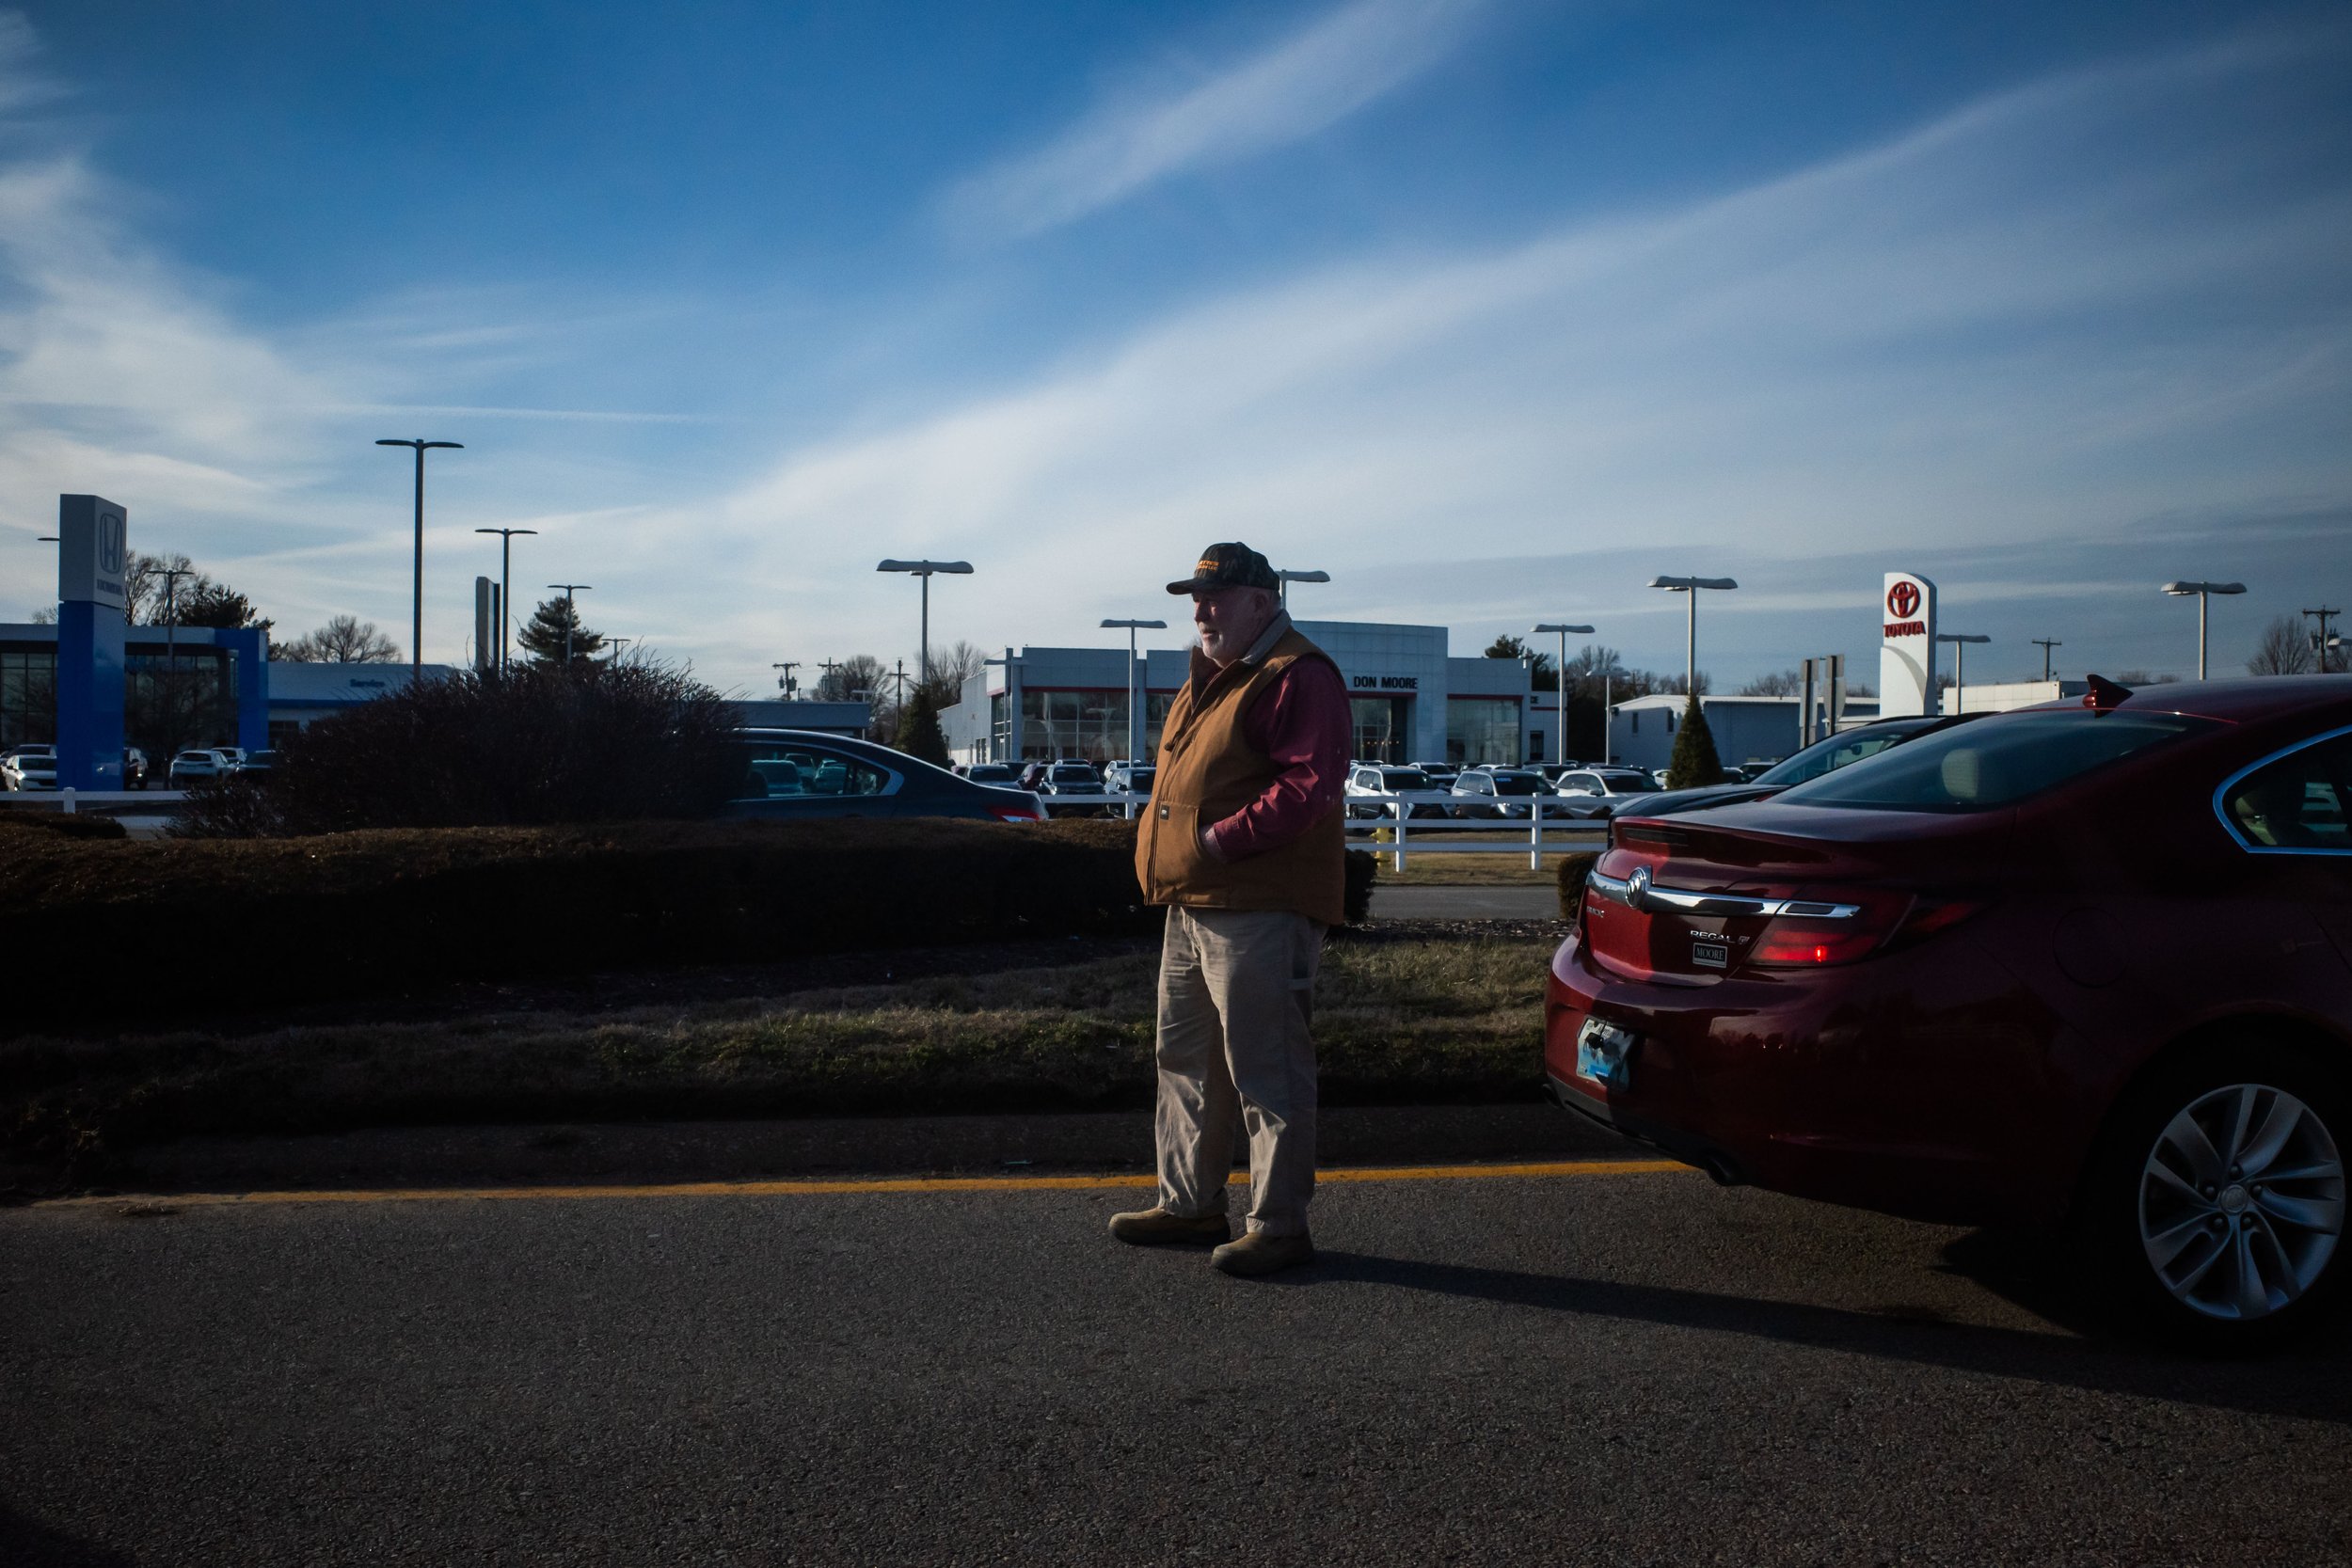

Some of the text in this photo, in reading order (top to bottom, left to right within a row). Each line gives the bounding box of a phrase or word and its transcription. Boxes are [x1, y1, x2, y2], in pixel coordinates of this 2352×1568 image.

[1883, 621, 1927, 638] TOYOTA
[1353, 676, 1418, 689] DON MOORE
[1690, 929, 1736, 943] REGAL
[1695, 946, 1724, 959] MOORE
